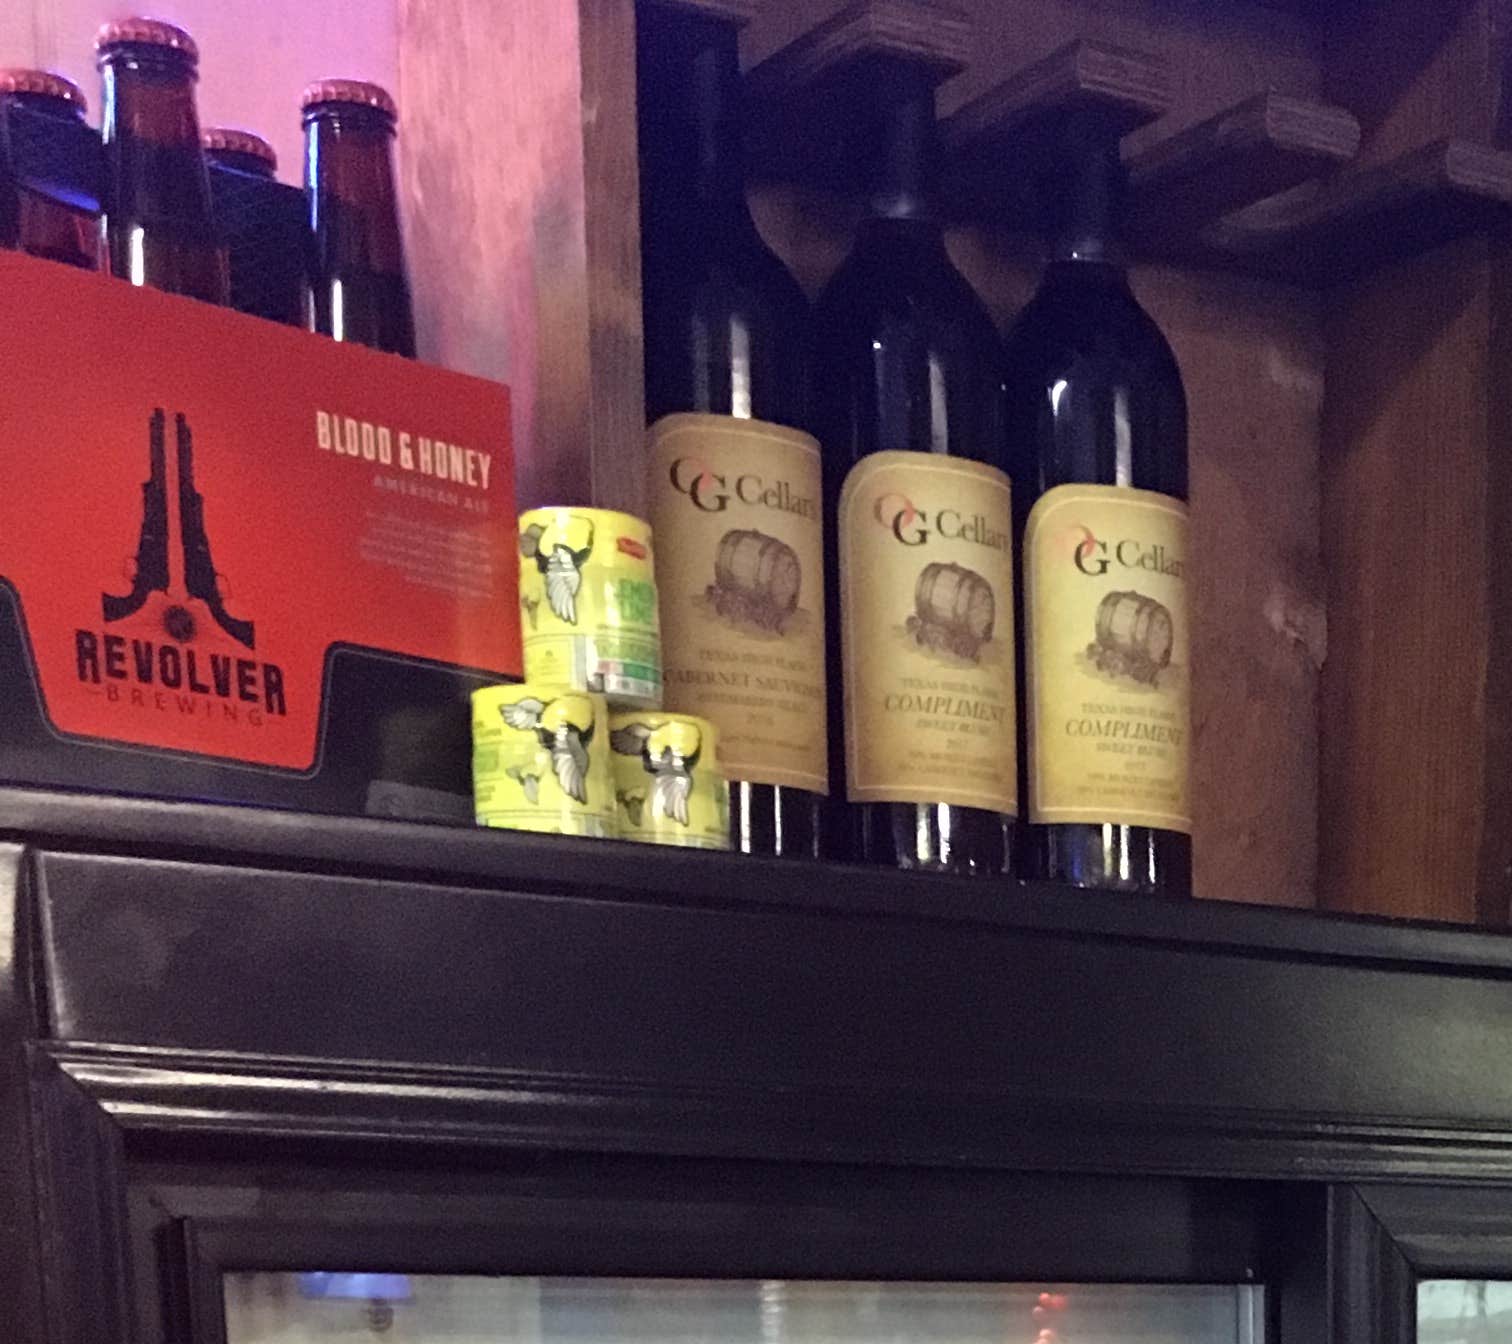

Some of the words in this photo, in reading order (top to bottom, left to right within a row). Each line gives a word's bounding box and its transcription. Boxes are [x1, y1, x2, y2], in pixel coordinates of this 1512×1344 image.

[316, 410, 392, 465] BLOOD
[399, 432, 414, 470] &
[418, 436, 491, 490] HONEY
[935, 508, 1010, 553] Cellar
[1115, 538, 1184, 579] Cellar
[75, 628, 287, 717] REVOLVER
[106, 684, 263, 727] BREWING
[1064, 717, 1186, 746] COMPLIMENT
